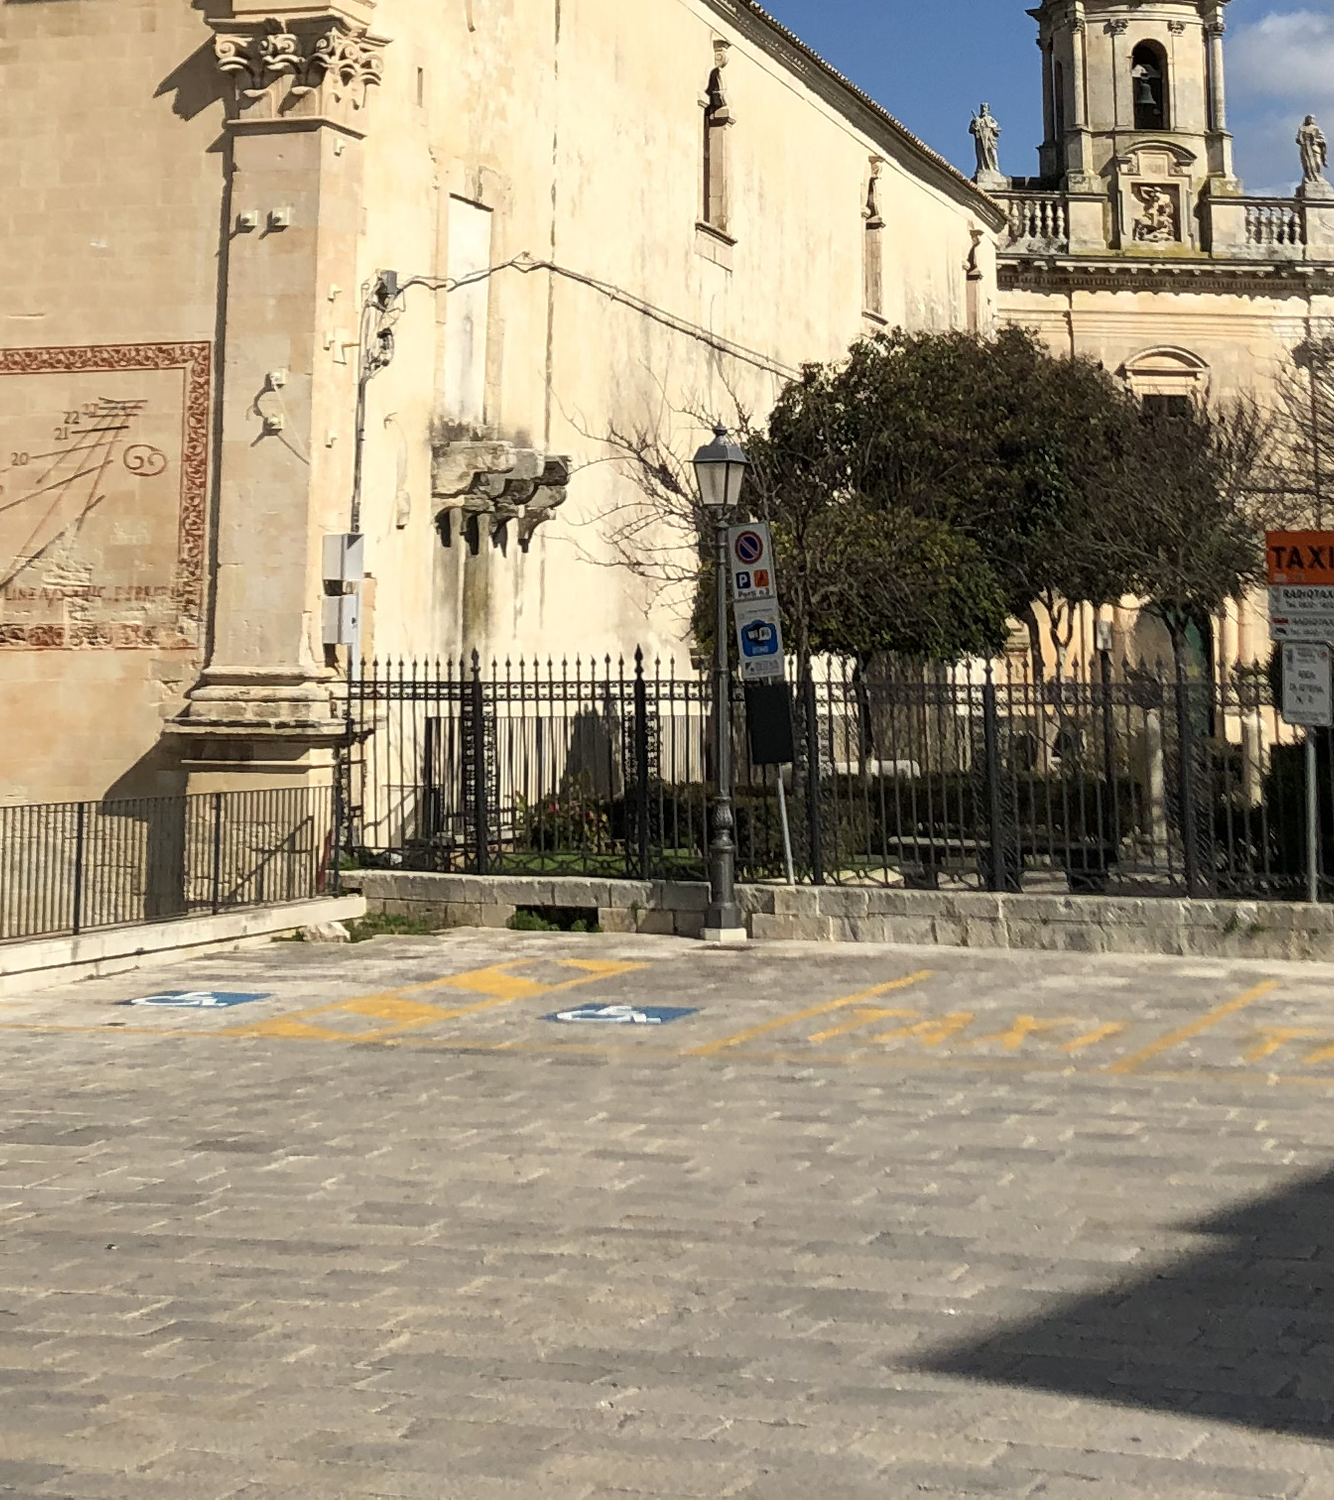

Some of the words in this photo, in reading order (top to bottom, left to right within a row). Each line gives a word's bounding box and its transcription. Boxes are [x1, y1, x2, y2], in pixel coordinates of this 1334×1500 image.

[64, 411, 80, 425] 22
[54, 428, 69, 441] 21
[11, 451, 29, 466] 20
[807, 1008, 1127, 1053] TAXI
